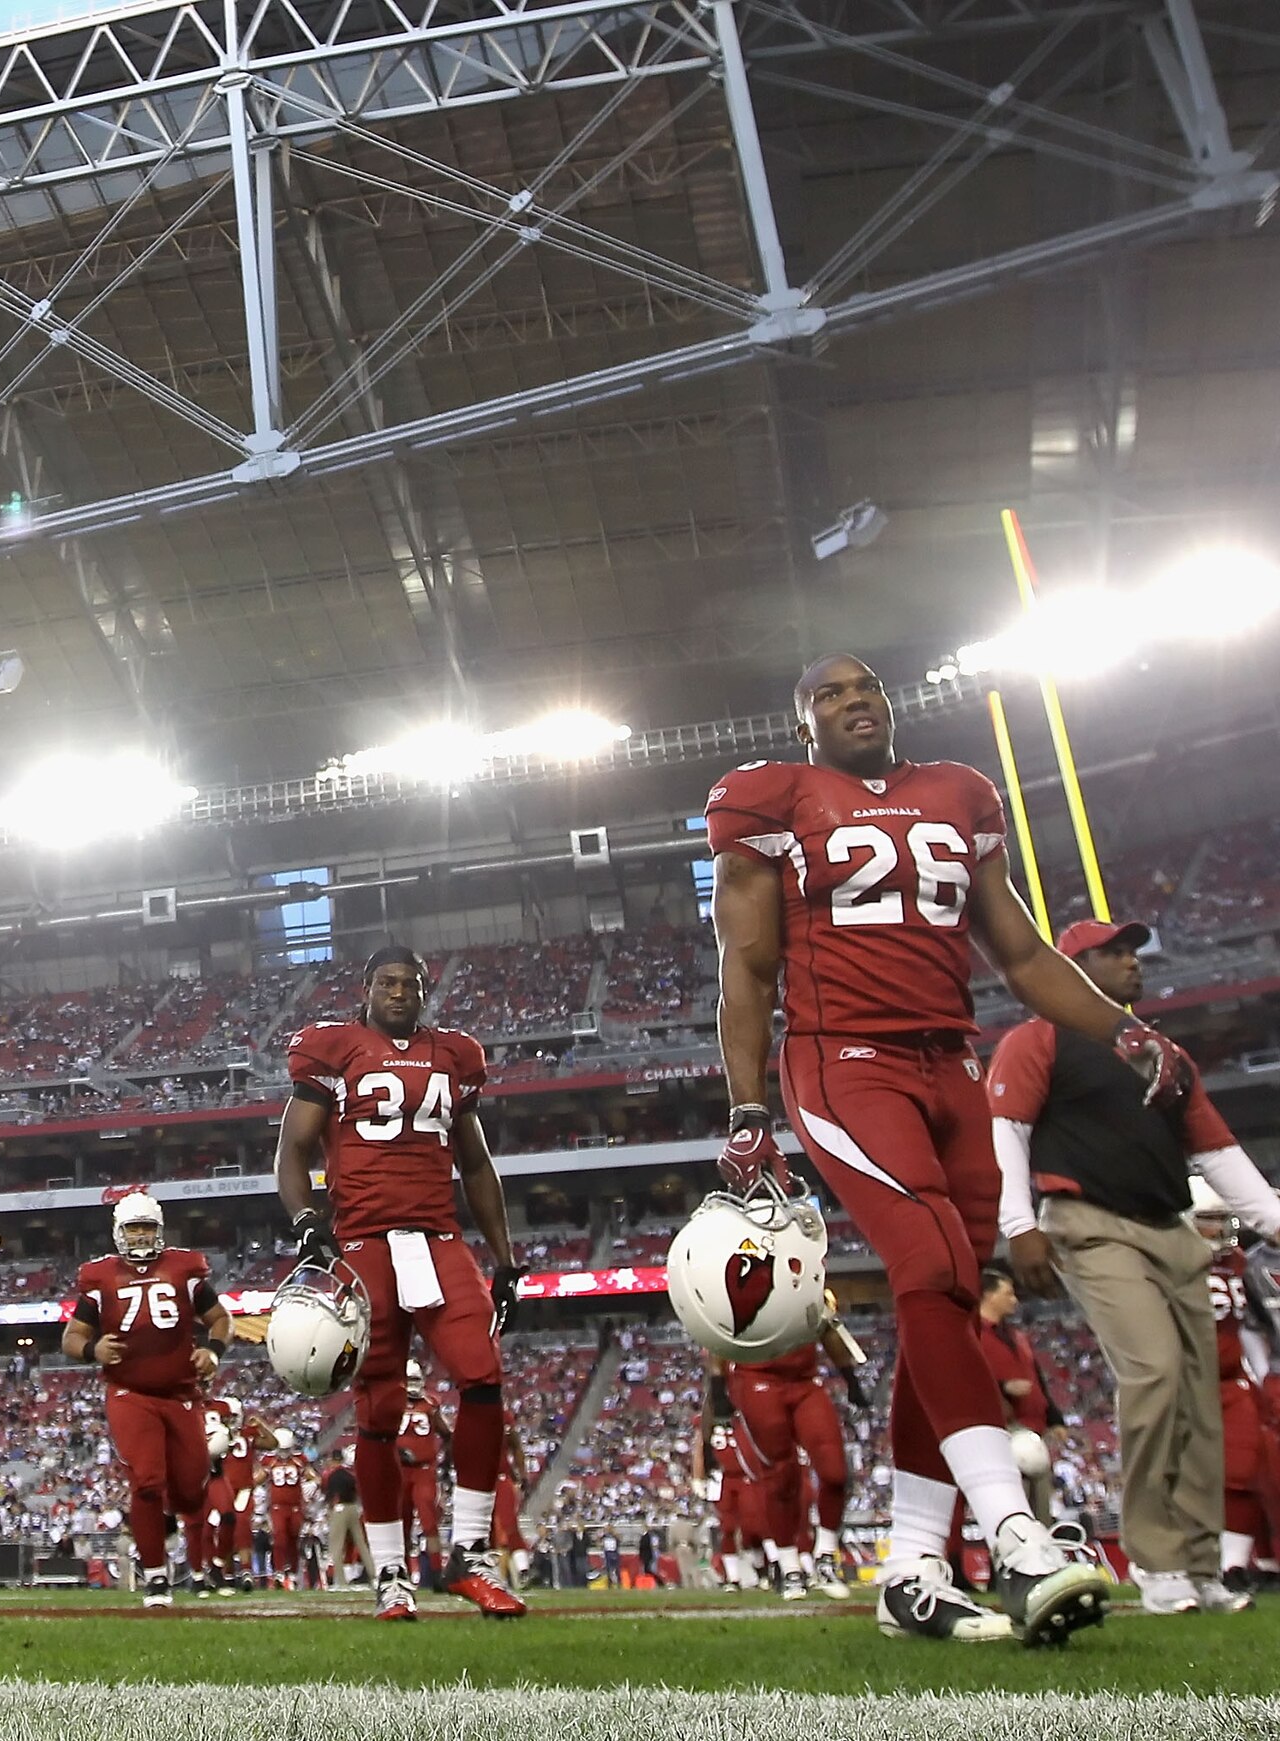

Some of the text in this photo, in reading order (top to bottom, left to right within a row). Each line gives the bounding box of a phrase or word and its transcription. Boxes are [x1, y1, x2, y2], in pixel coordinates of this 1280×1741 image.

[852, 808, 922, 818] CARDINALS
[826, 822, 970, 927] 26
[382, 1059, 432, 1068] CARDINALS
[645, 1065, 710, 1081] CHARLEY
[355, 1072, 453, 1147] 34
[182, 1181, 259, 1195] GILA RIVER
[117, 1283, 180, 1332] 76
